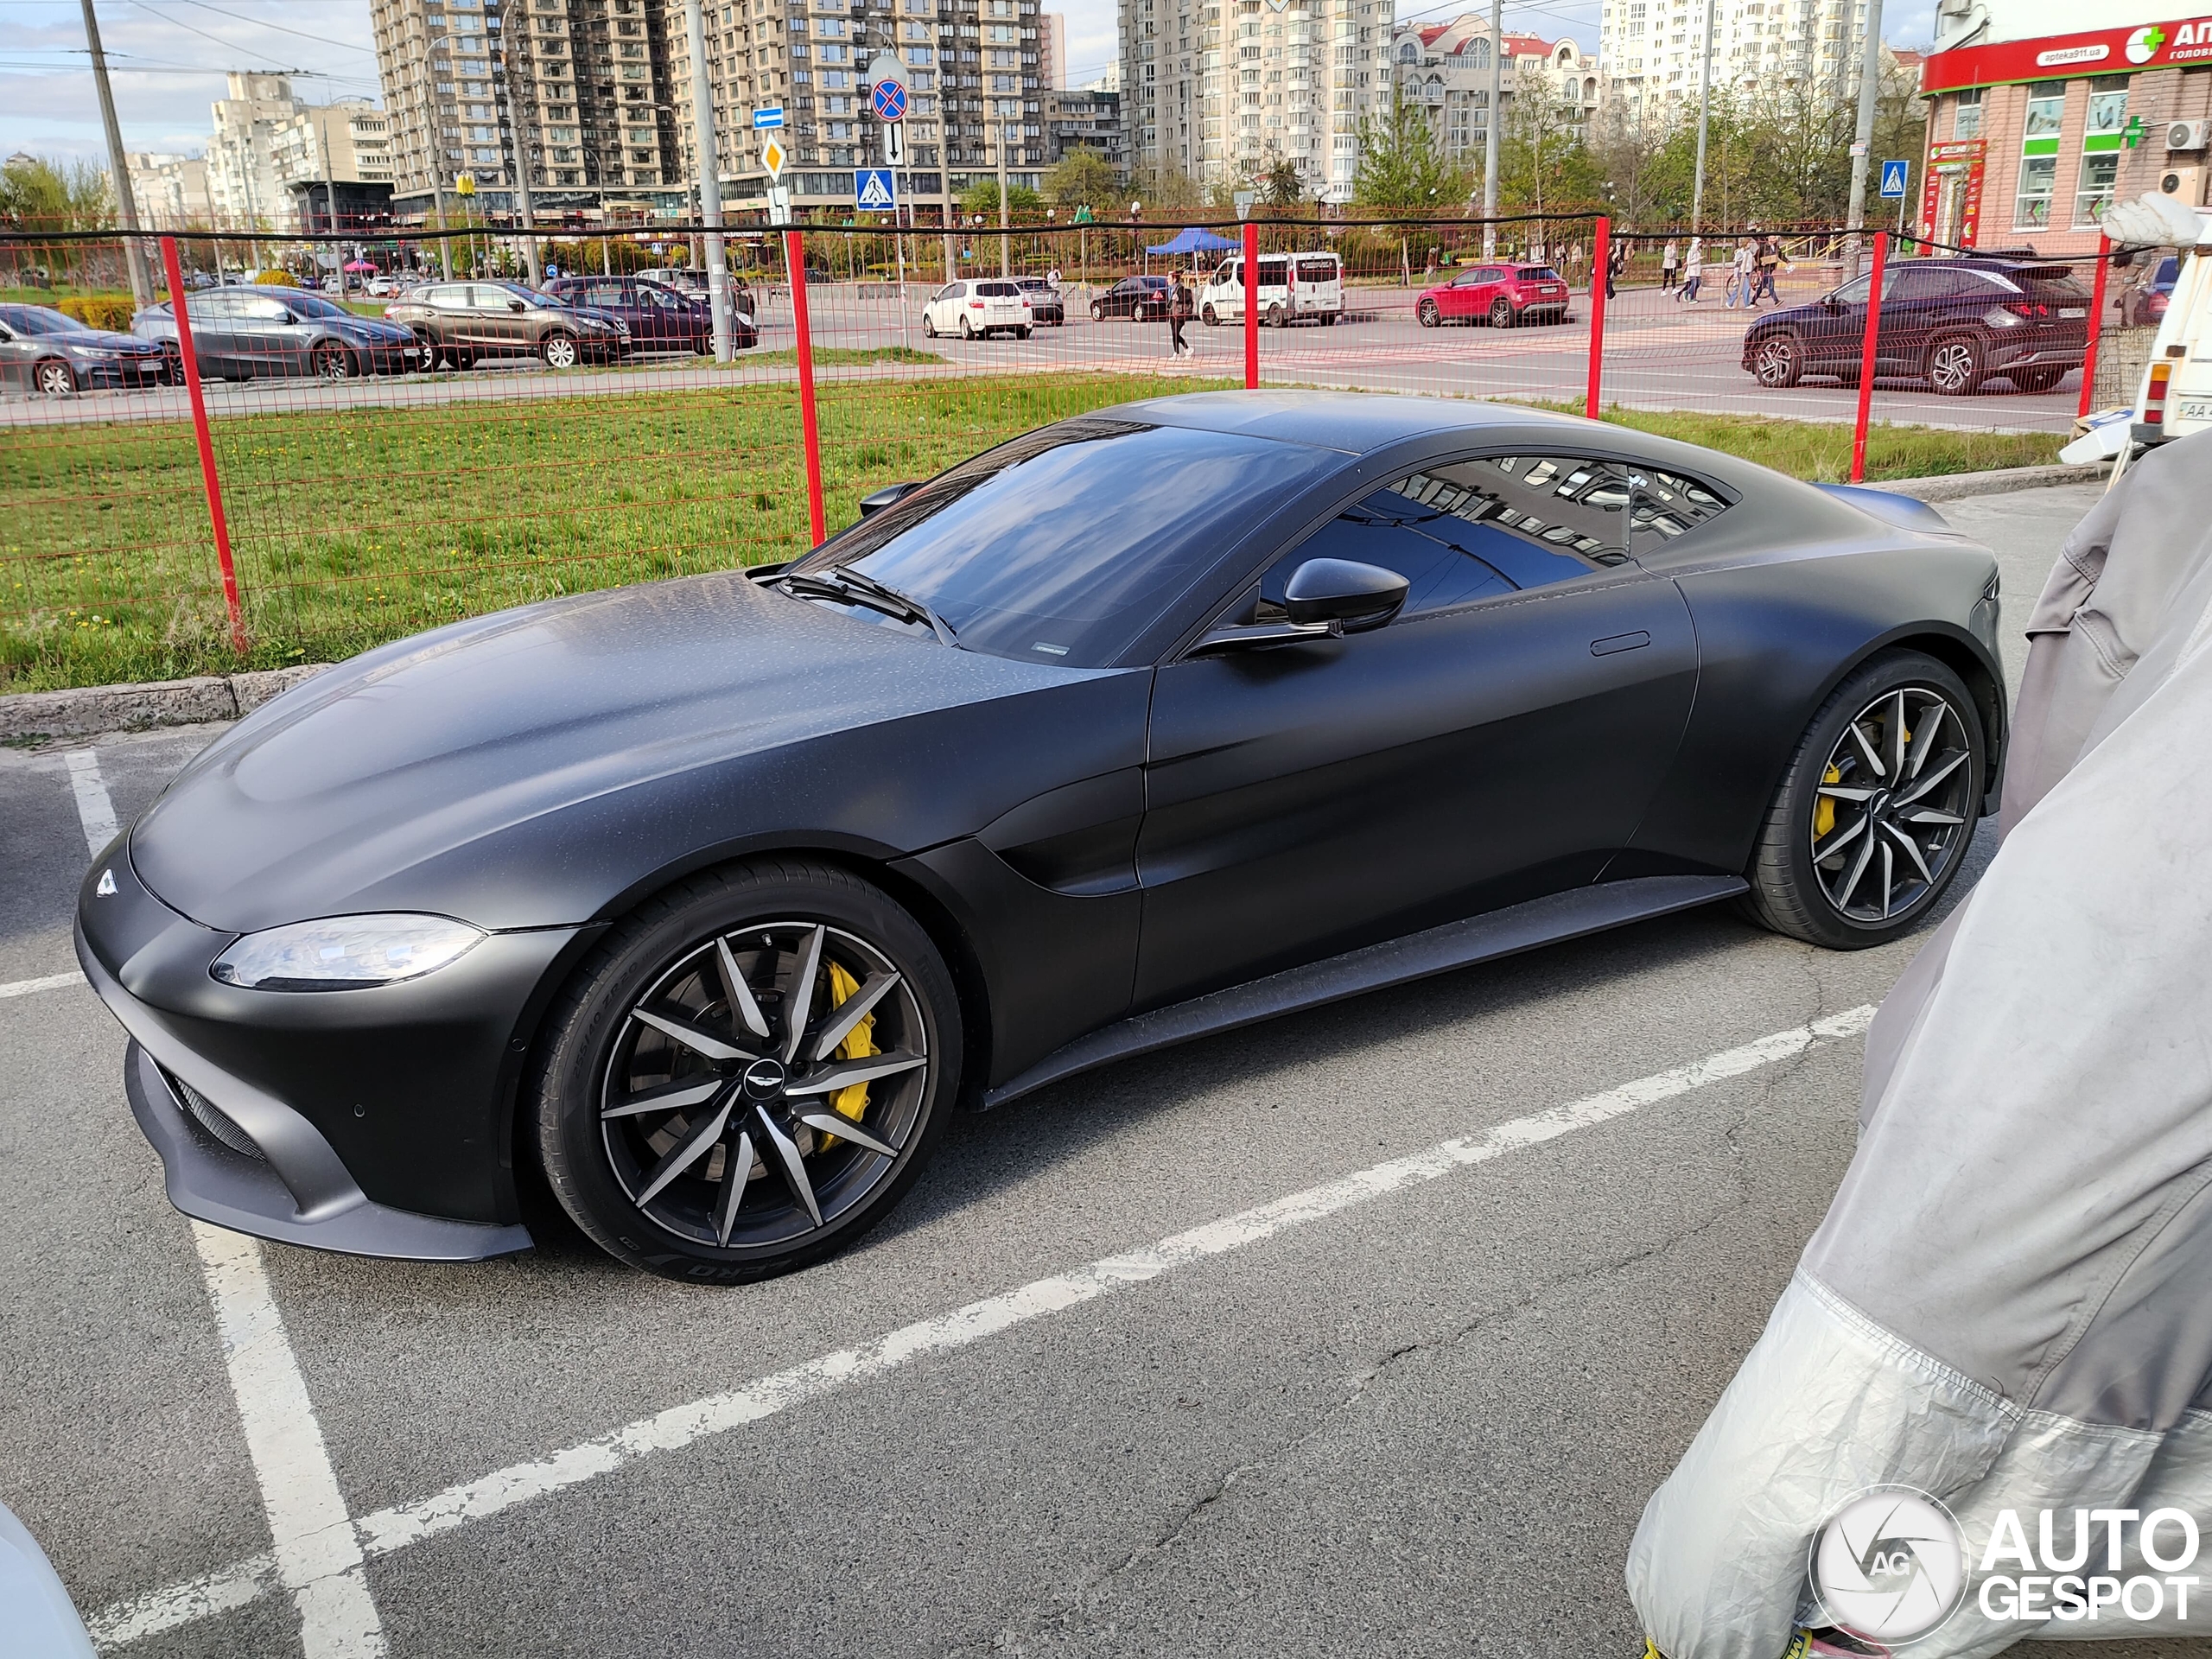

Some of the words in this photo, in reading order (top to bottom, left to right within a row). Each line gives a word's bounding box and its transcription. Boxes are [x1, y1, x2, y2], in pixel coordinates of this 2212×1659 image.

[2044, 48, 2101, 62] apteka911.ua
[2185, 404, 2205, 418] AA
[572, 1012, 601, 1079] 255/40
[602, 962, 639, 1009] ZR20
